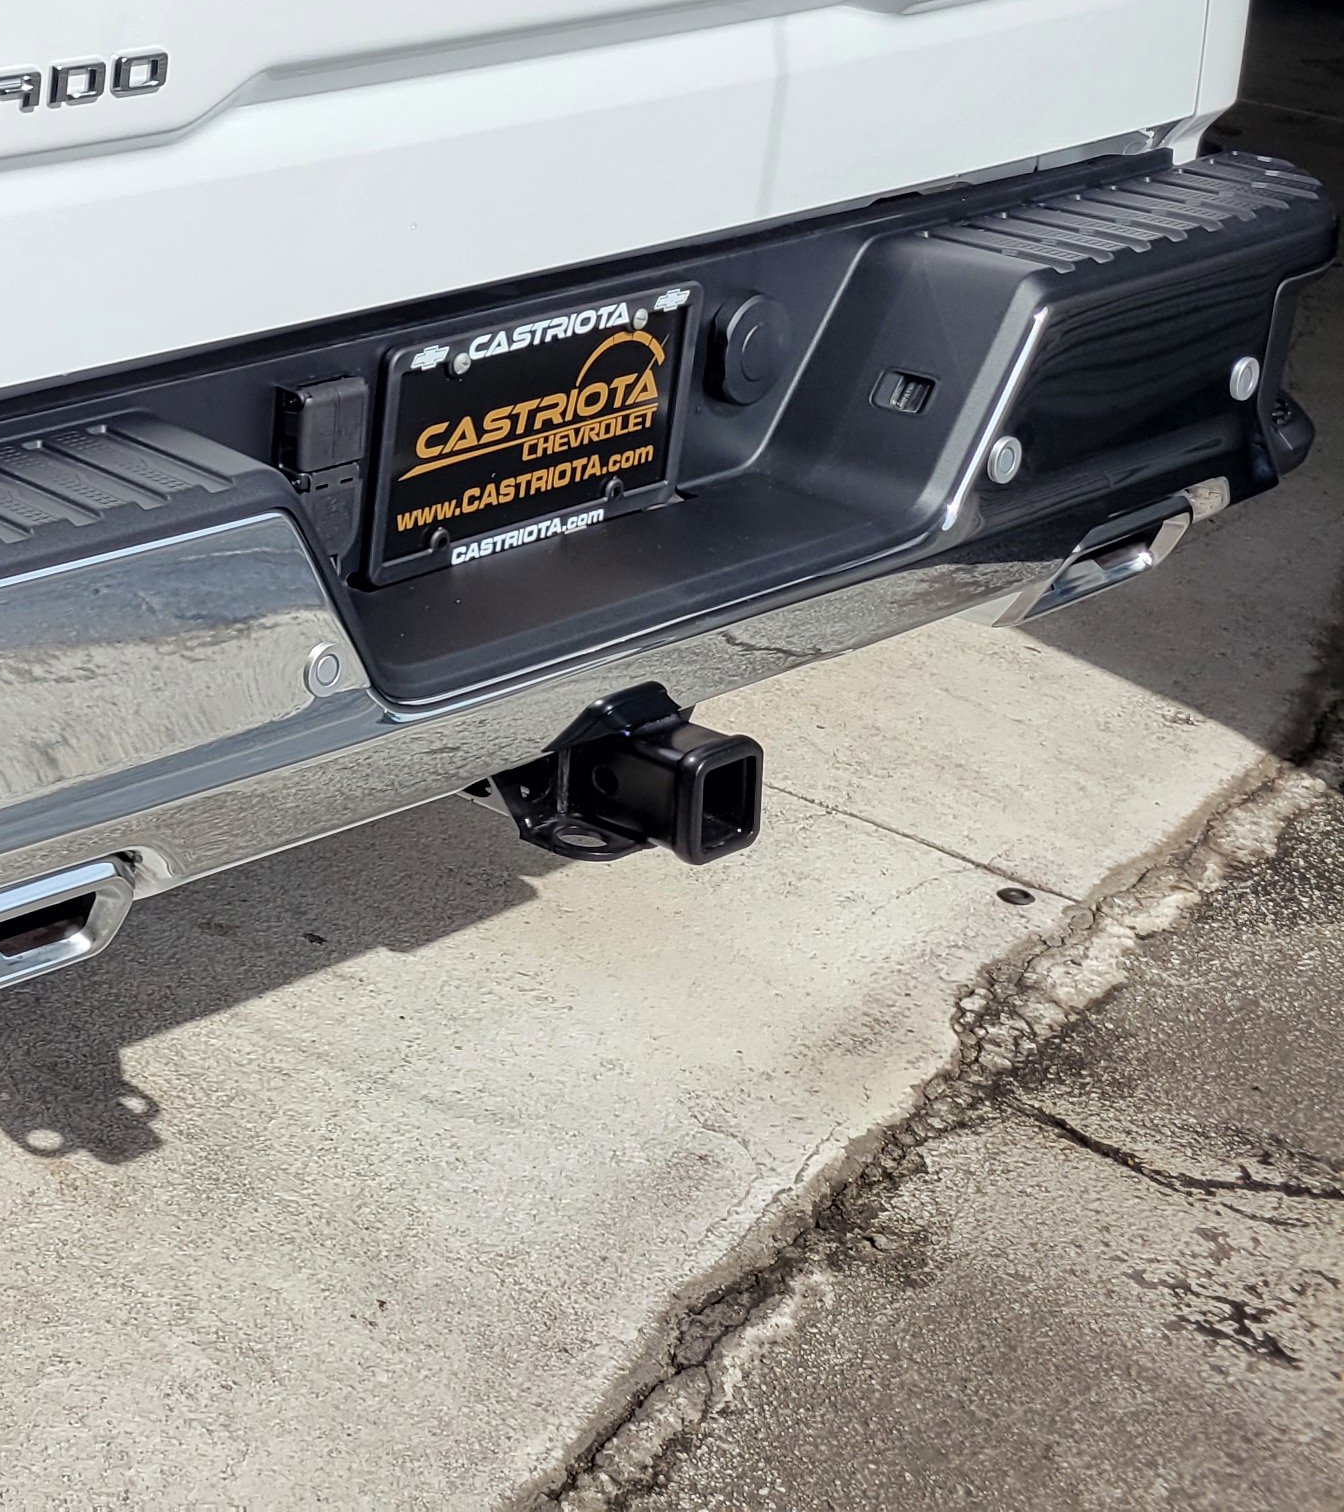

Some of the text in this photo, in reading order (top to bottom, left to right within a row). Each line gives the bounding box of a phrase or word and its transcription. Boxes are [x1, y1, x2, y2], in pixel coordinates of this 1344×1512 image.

[468, 302, 631, 360] CASTRIOTA
[415, 369, 659, 459] CASTRIOTA
[521, 407, 656, 462] CHEVROLET
[396, 444, 654, 532] www.CASTRIOTA.com
[450, 507, 605, 566] CASTRIOTA.com
